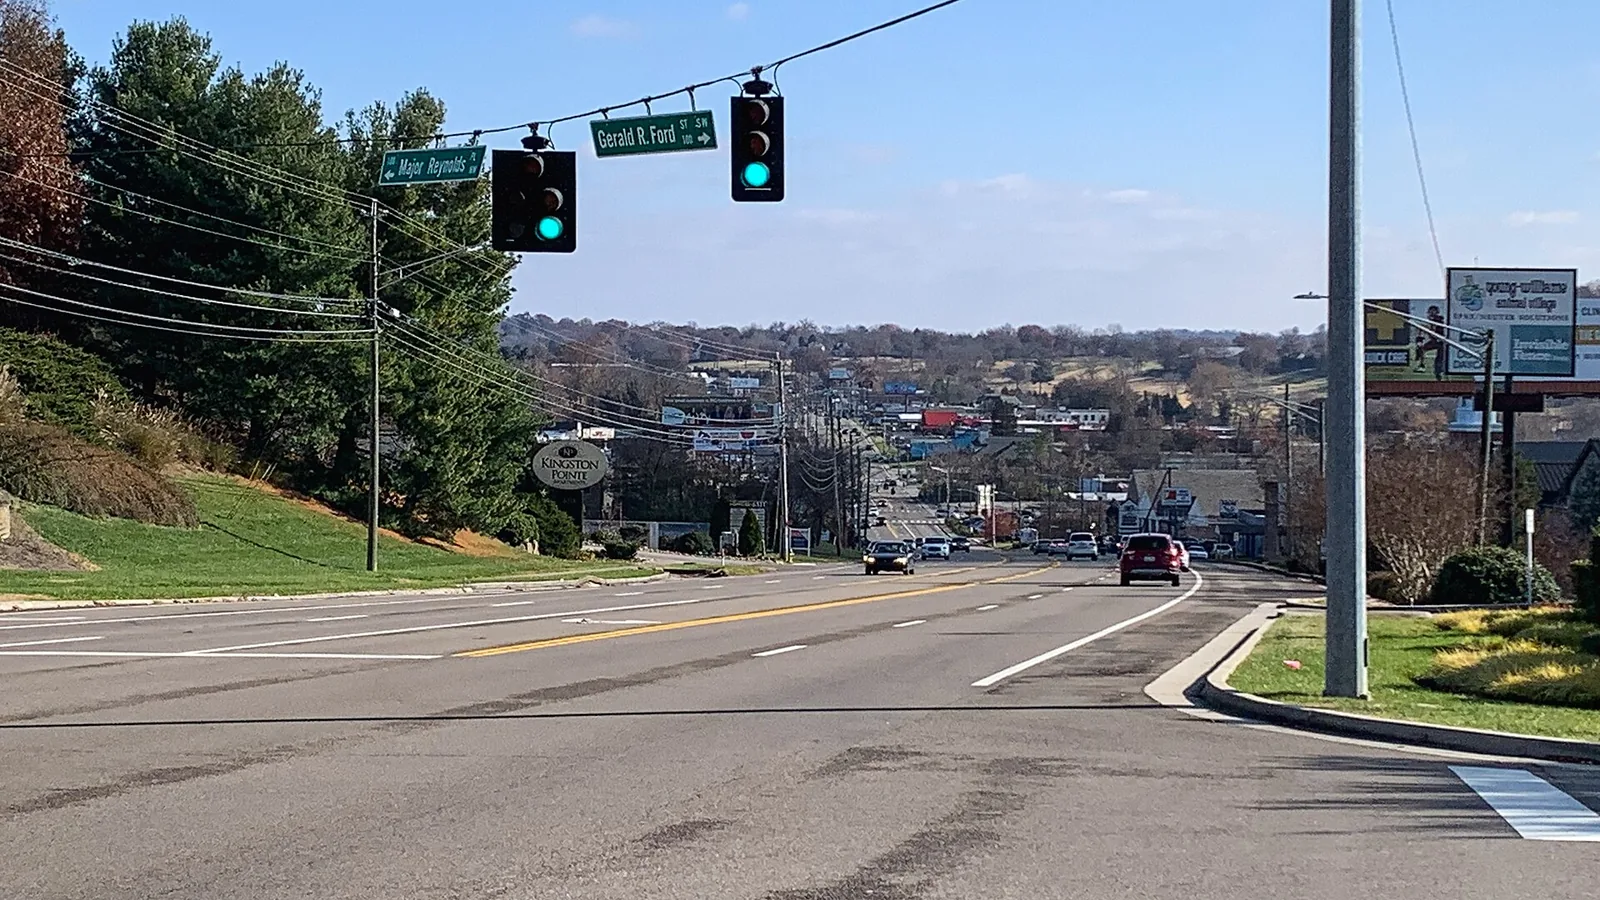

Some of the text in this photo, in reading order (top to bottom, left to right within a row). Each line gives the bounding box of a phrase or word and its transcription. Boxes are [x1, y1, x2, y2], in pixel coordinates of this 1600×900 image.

[680, 117, 708, 130] ST SW
[597, 124, 676, 149] Gerald R. Ford
[398, 155, 467, 179] Major Reynolds
[541, 456, 599, 470] KINGSTON
[552, 470, 588, 480] POINTE
